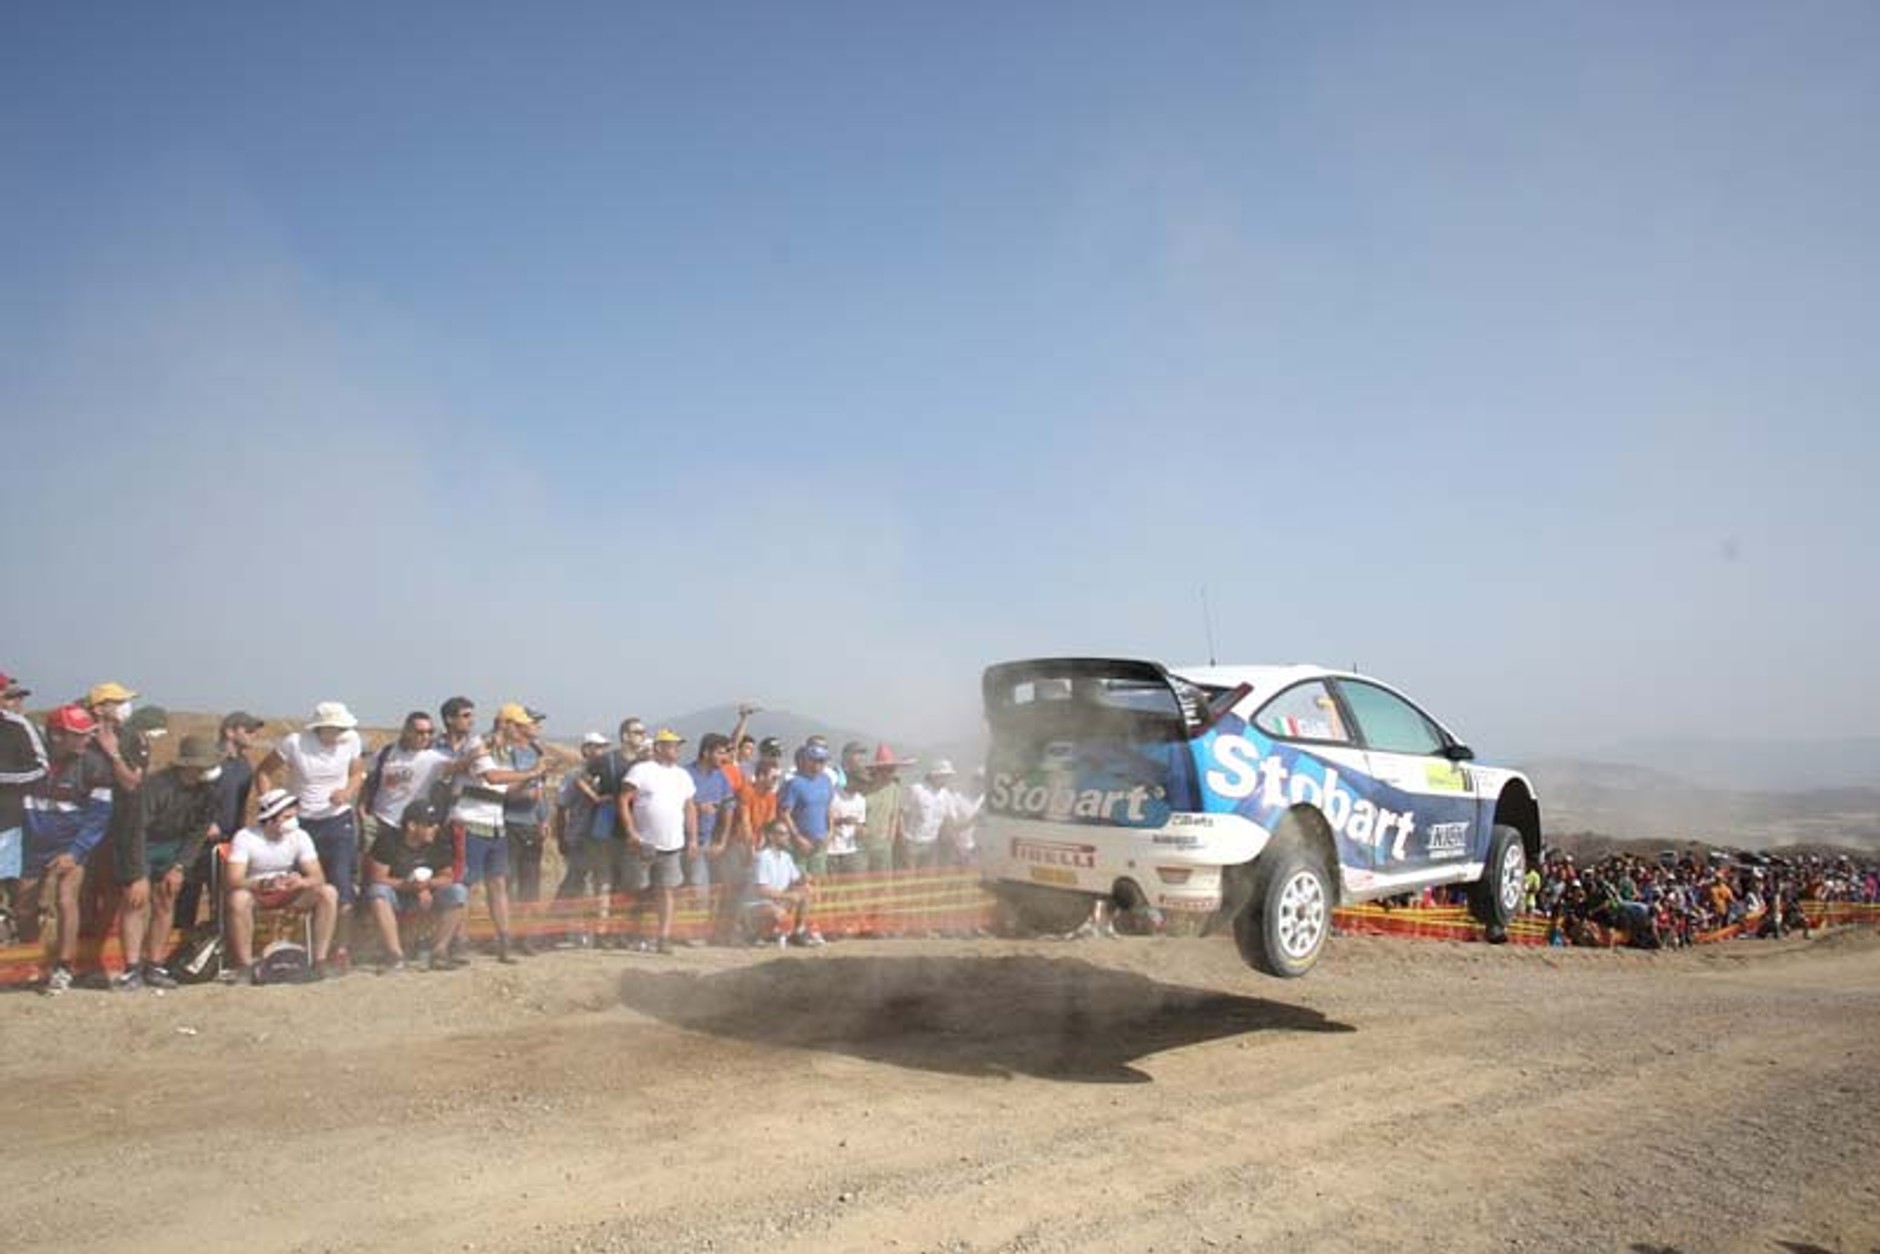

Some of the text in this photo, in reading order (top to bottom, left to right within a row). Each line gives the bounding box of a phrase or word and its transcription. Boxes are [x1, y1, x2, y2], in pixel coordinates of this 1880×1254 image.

[989, 773, 1149, 822] Stobart
[1206, 733, 1415, 861] Stobart
[1010, 837, 1096, 869] PIRELLI
